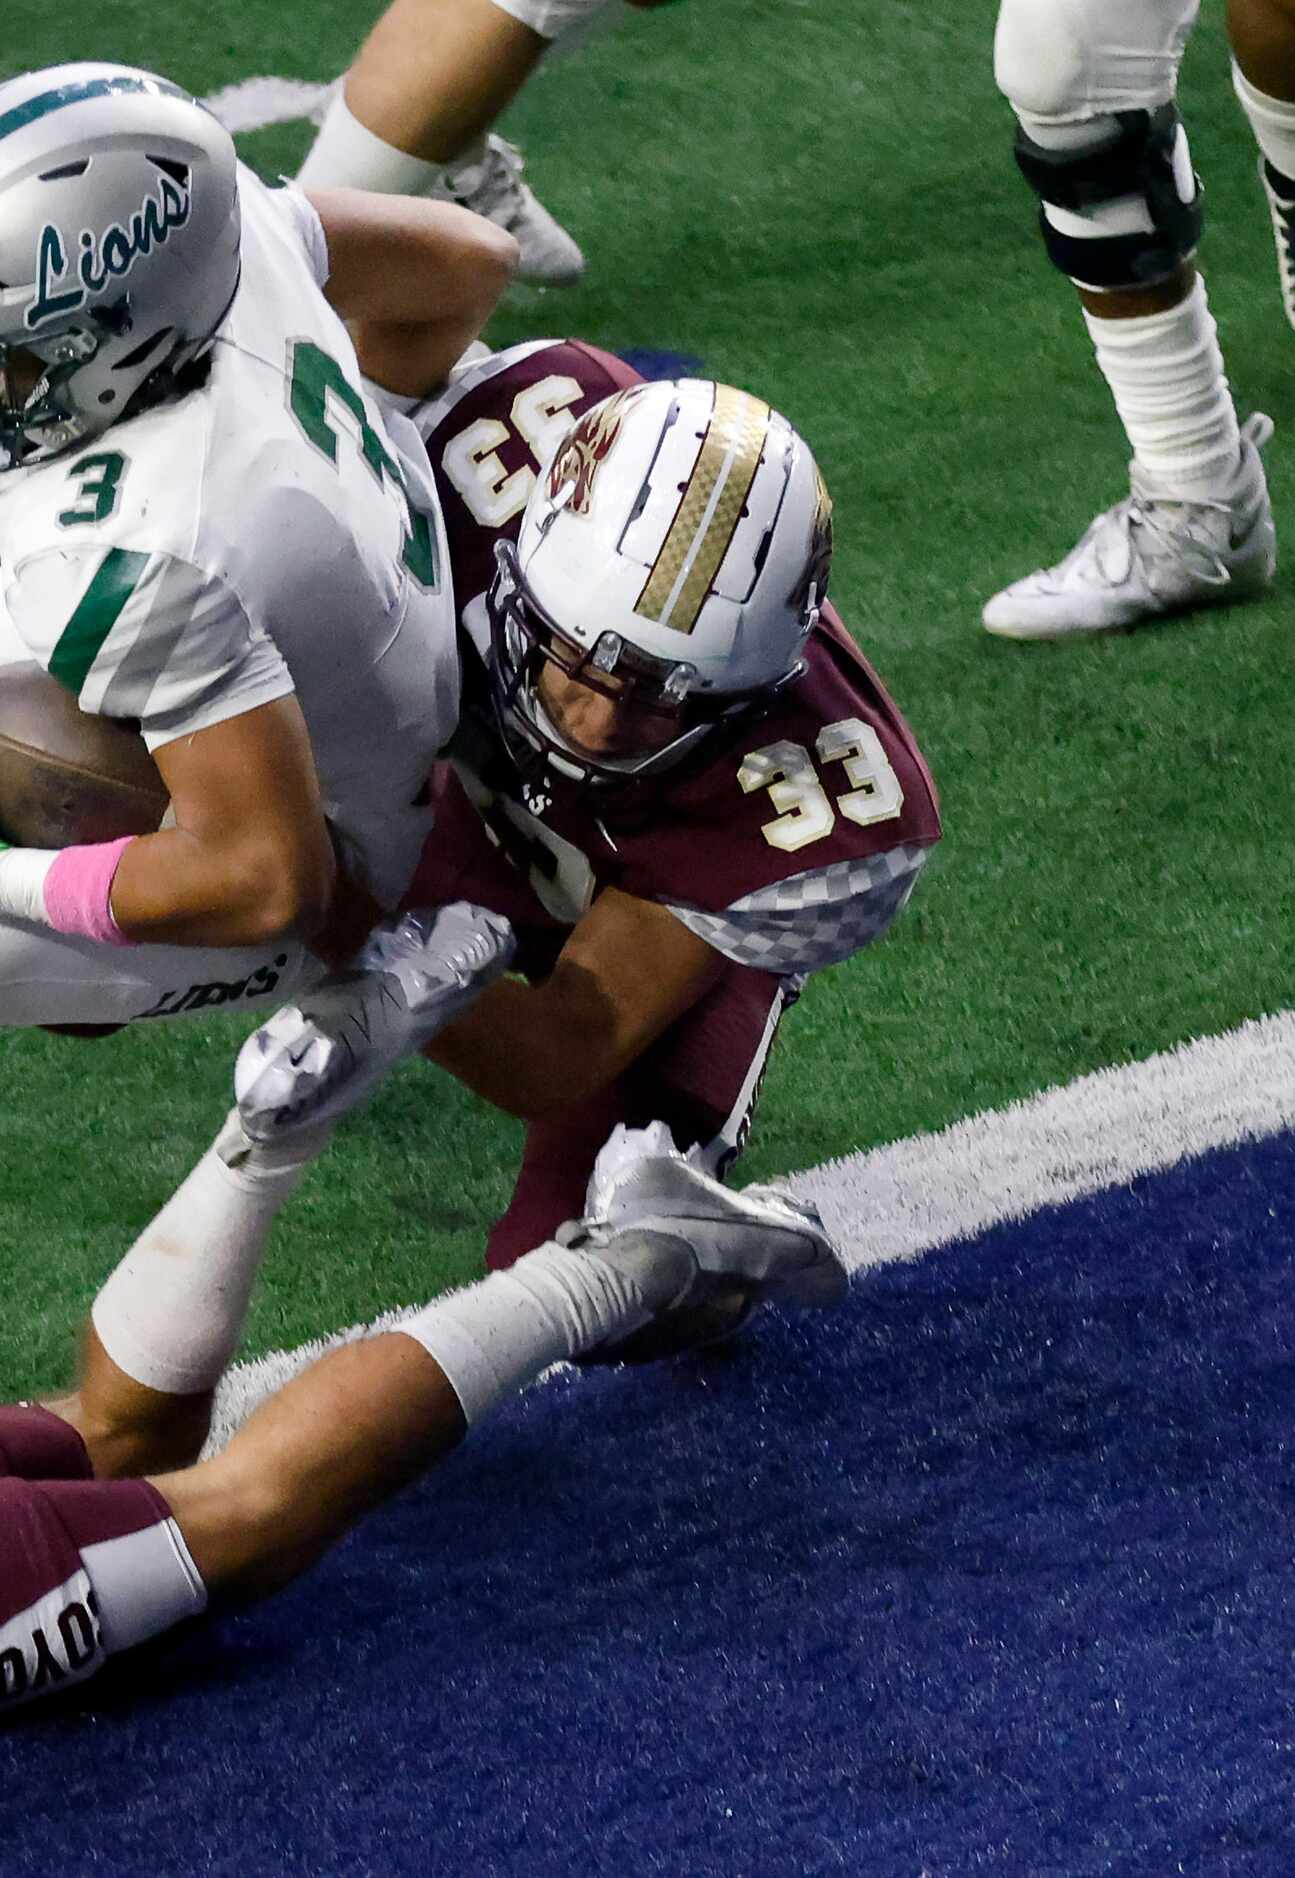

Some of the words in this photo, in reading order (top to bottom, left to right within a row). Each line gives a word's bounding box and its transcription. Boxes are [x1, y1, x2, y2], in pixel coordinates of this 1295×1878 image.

[25, 172, 193, 330] Lions
[56, 449, 132, 530] 3
[441, 374, 586, 527] 33
[736, 716, 905, 852] 33
